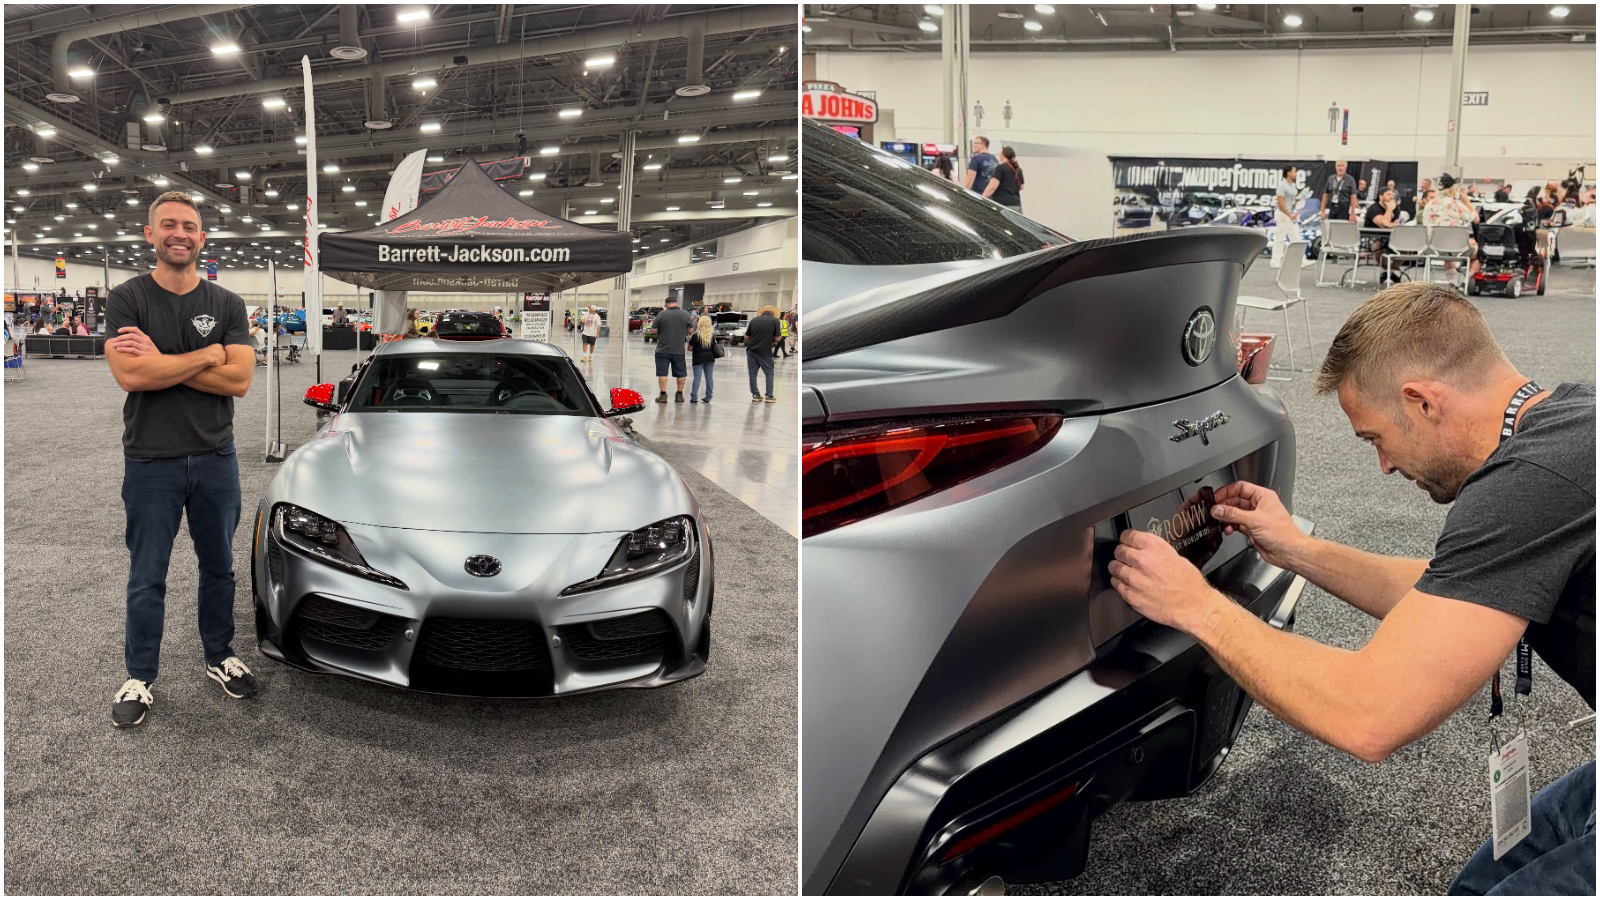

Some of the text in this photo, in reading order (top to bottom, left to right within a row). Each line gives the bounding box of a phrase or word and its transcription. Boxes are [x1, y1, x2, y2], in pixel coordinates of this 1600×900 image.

[807, 83, 834, 91] PIZZA
[1463, 93, 1487, 105] EXIT
[818, 95, 873, 119] JOHNS
[378, 244, 570, 262] Barrett-Jackson.com
